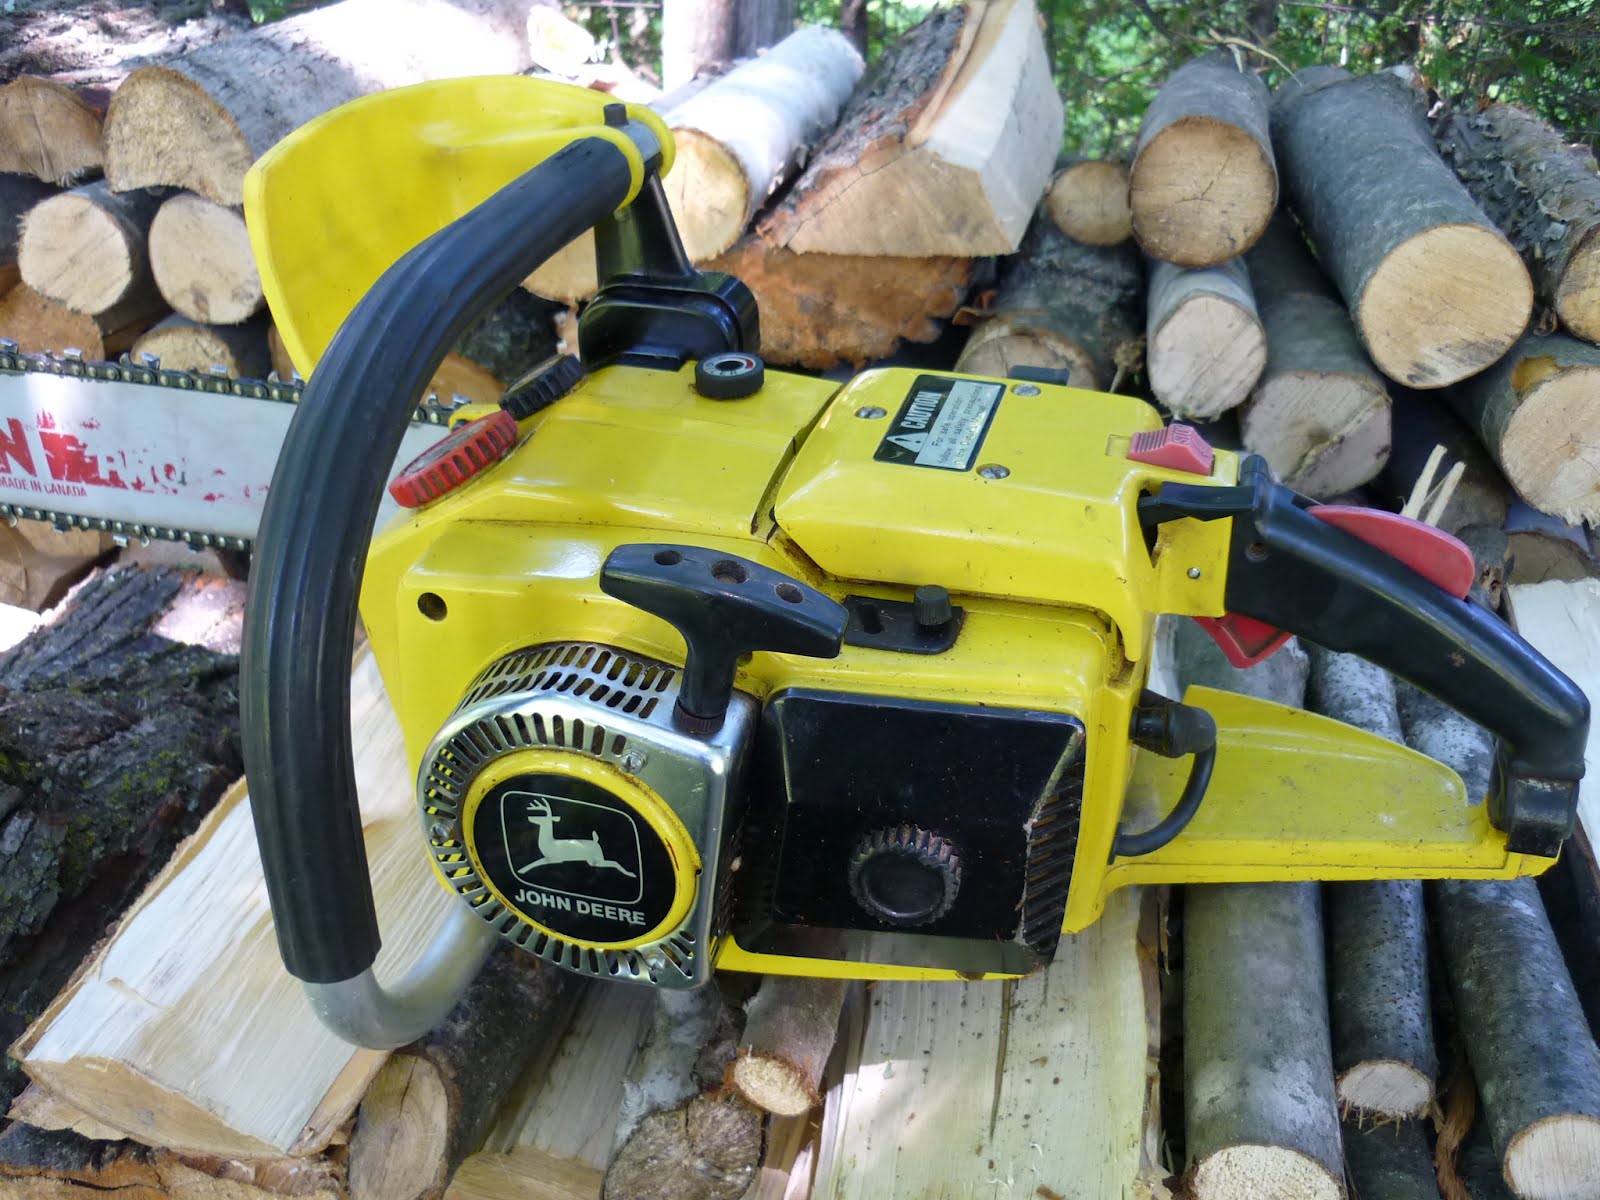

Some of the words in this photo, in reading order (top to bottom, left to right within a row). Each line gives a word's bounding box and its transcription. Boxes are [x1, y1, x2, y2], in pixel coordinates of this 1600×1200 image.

[900, 391, 942, 429] CAUTION
[931, 436, 944, 447] For
[939, 422, 951, 434] safe
[953, 417, 968, 435] safety
[31, 481, 43, 492] IN
[44, 483, 88, 498] CANADA
[514, 888, 571, 912] JOHN
[577, 901, 647, 926] DEERE
